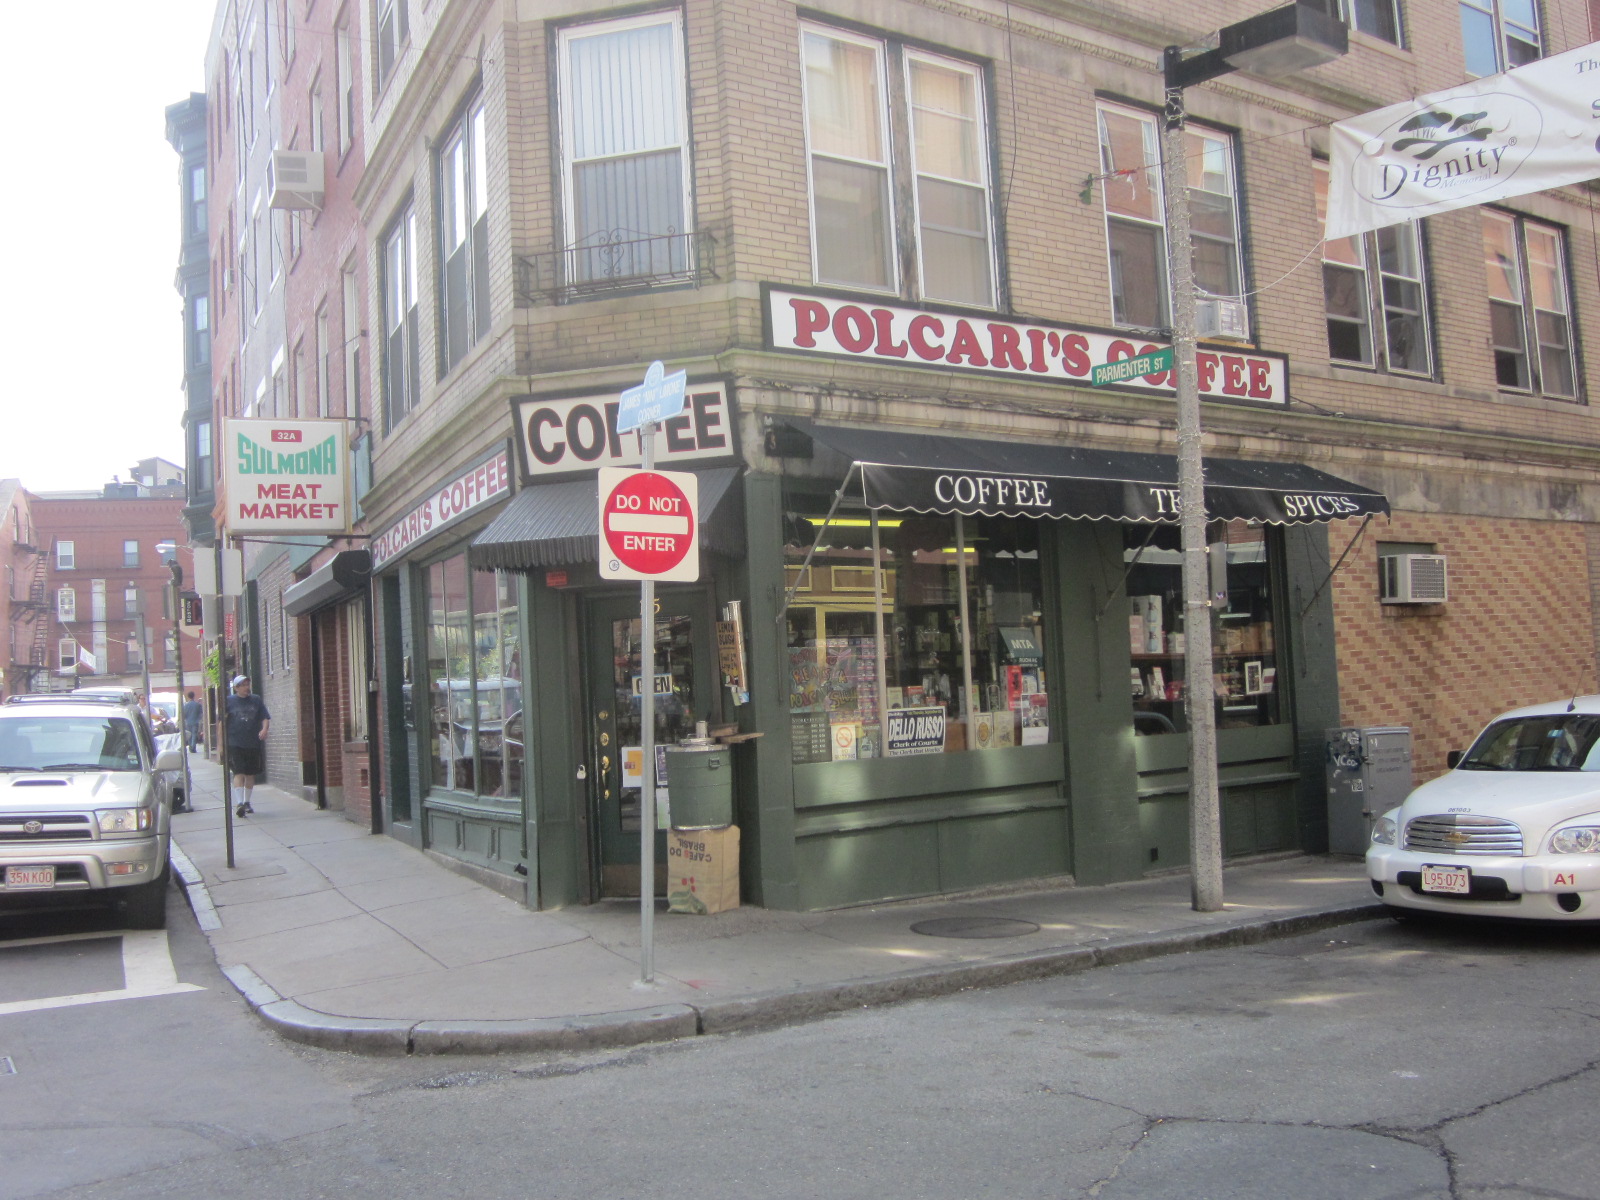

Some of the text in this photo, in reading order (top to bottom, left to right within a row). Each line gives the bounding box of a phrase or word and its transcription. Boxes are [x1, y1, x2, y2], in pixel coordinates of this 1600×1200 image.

[1574, 58, 1600, 75] Th
[1440, 168, 1491, 189] Memorial
[789, 298, 1091, 377] POLCARI'S
[1096, 357, 1164, 384] PARMENTER ST
[277, 432, 296, 440] 32A
[237, 432, 337, 475] SULMONA
[258, 484, 322, 500] MEAT
[935, 475, 1052, 506] COFFEE
[239, 503, 339, 519] MARKET
[372, 455, 508, 567] POLCARI'S COFFEE
[616, 494, 681, 512] DO NOT
[1284, 495, 1360, 517] SPICES
[623, 535, 675, 552] ENTER
[1011, 639, 1034, 649] MTA
[636, 677, 671, 695] OEN
[889, 715, 943, 741] DELLO RUSSO
[669, 847, 682, 857] DO
[677, 838, 706, 852] BRASIL
